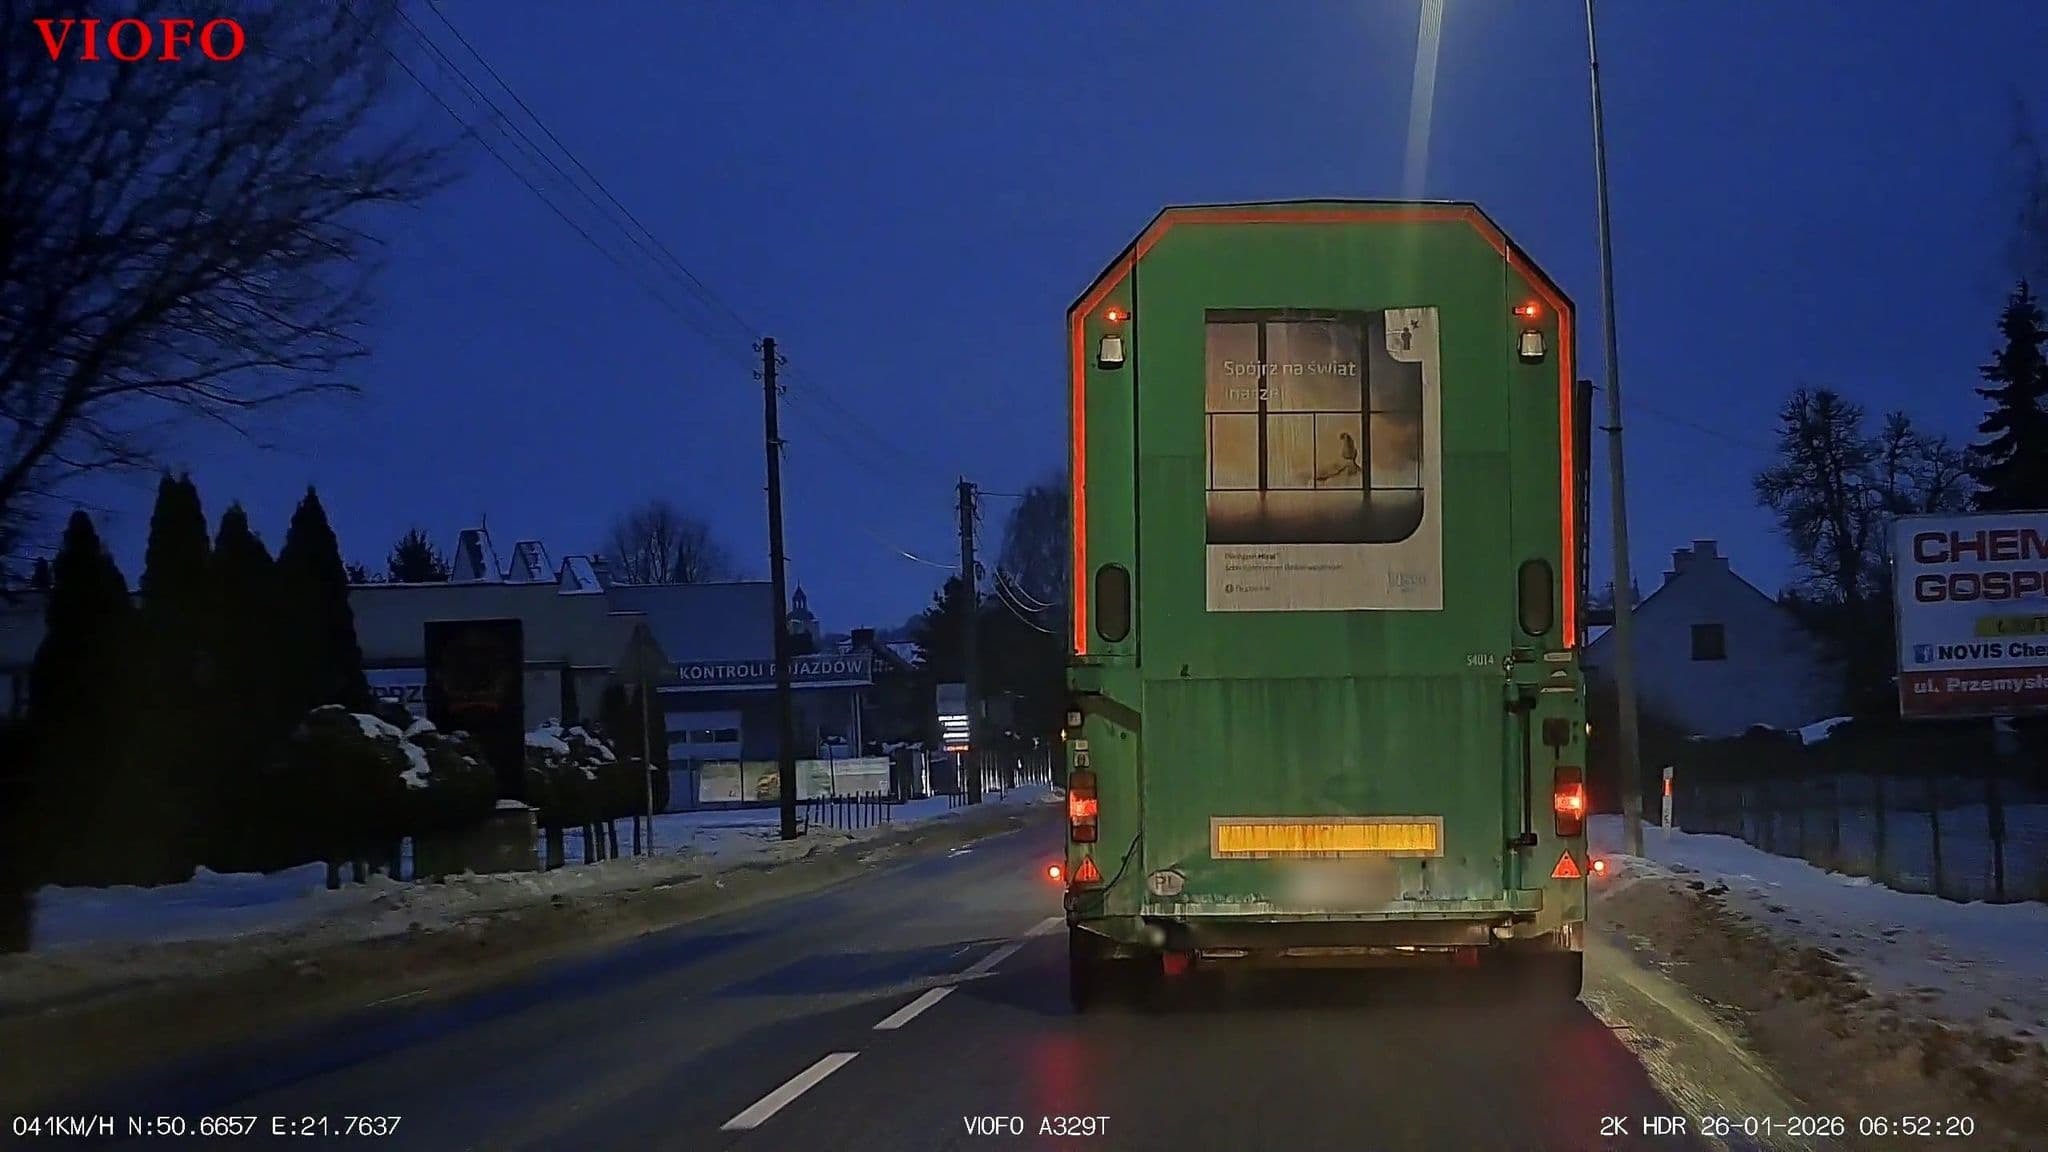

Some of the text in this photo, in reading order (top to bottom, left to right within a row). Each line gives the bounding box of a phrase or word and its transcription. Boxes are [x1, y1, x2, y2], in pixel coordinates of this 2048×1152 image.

[1223, 360, 1357, 380] Spójrz na świat
[1915, 570, 2048, 602] GOSP
[1938, 642, 2048, 660] NOVIS Che
[680, 659, 863, 679] KONTROLI PJAZDÓW
[1914, 678, 1939, 693] ul.
[1154, 875, 1175, 890] PL
